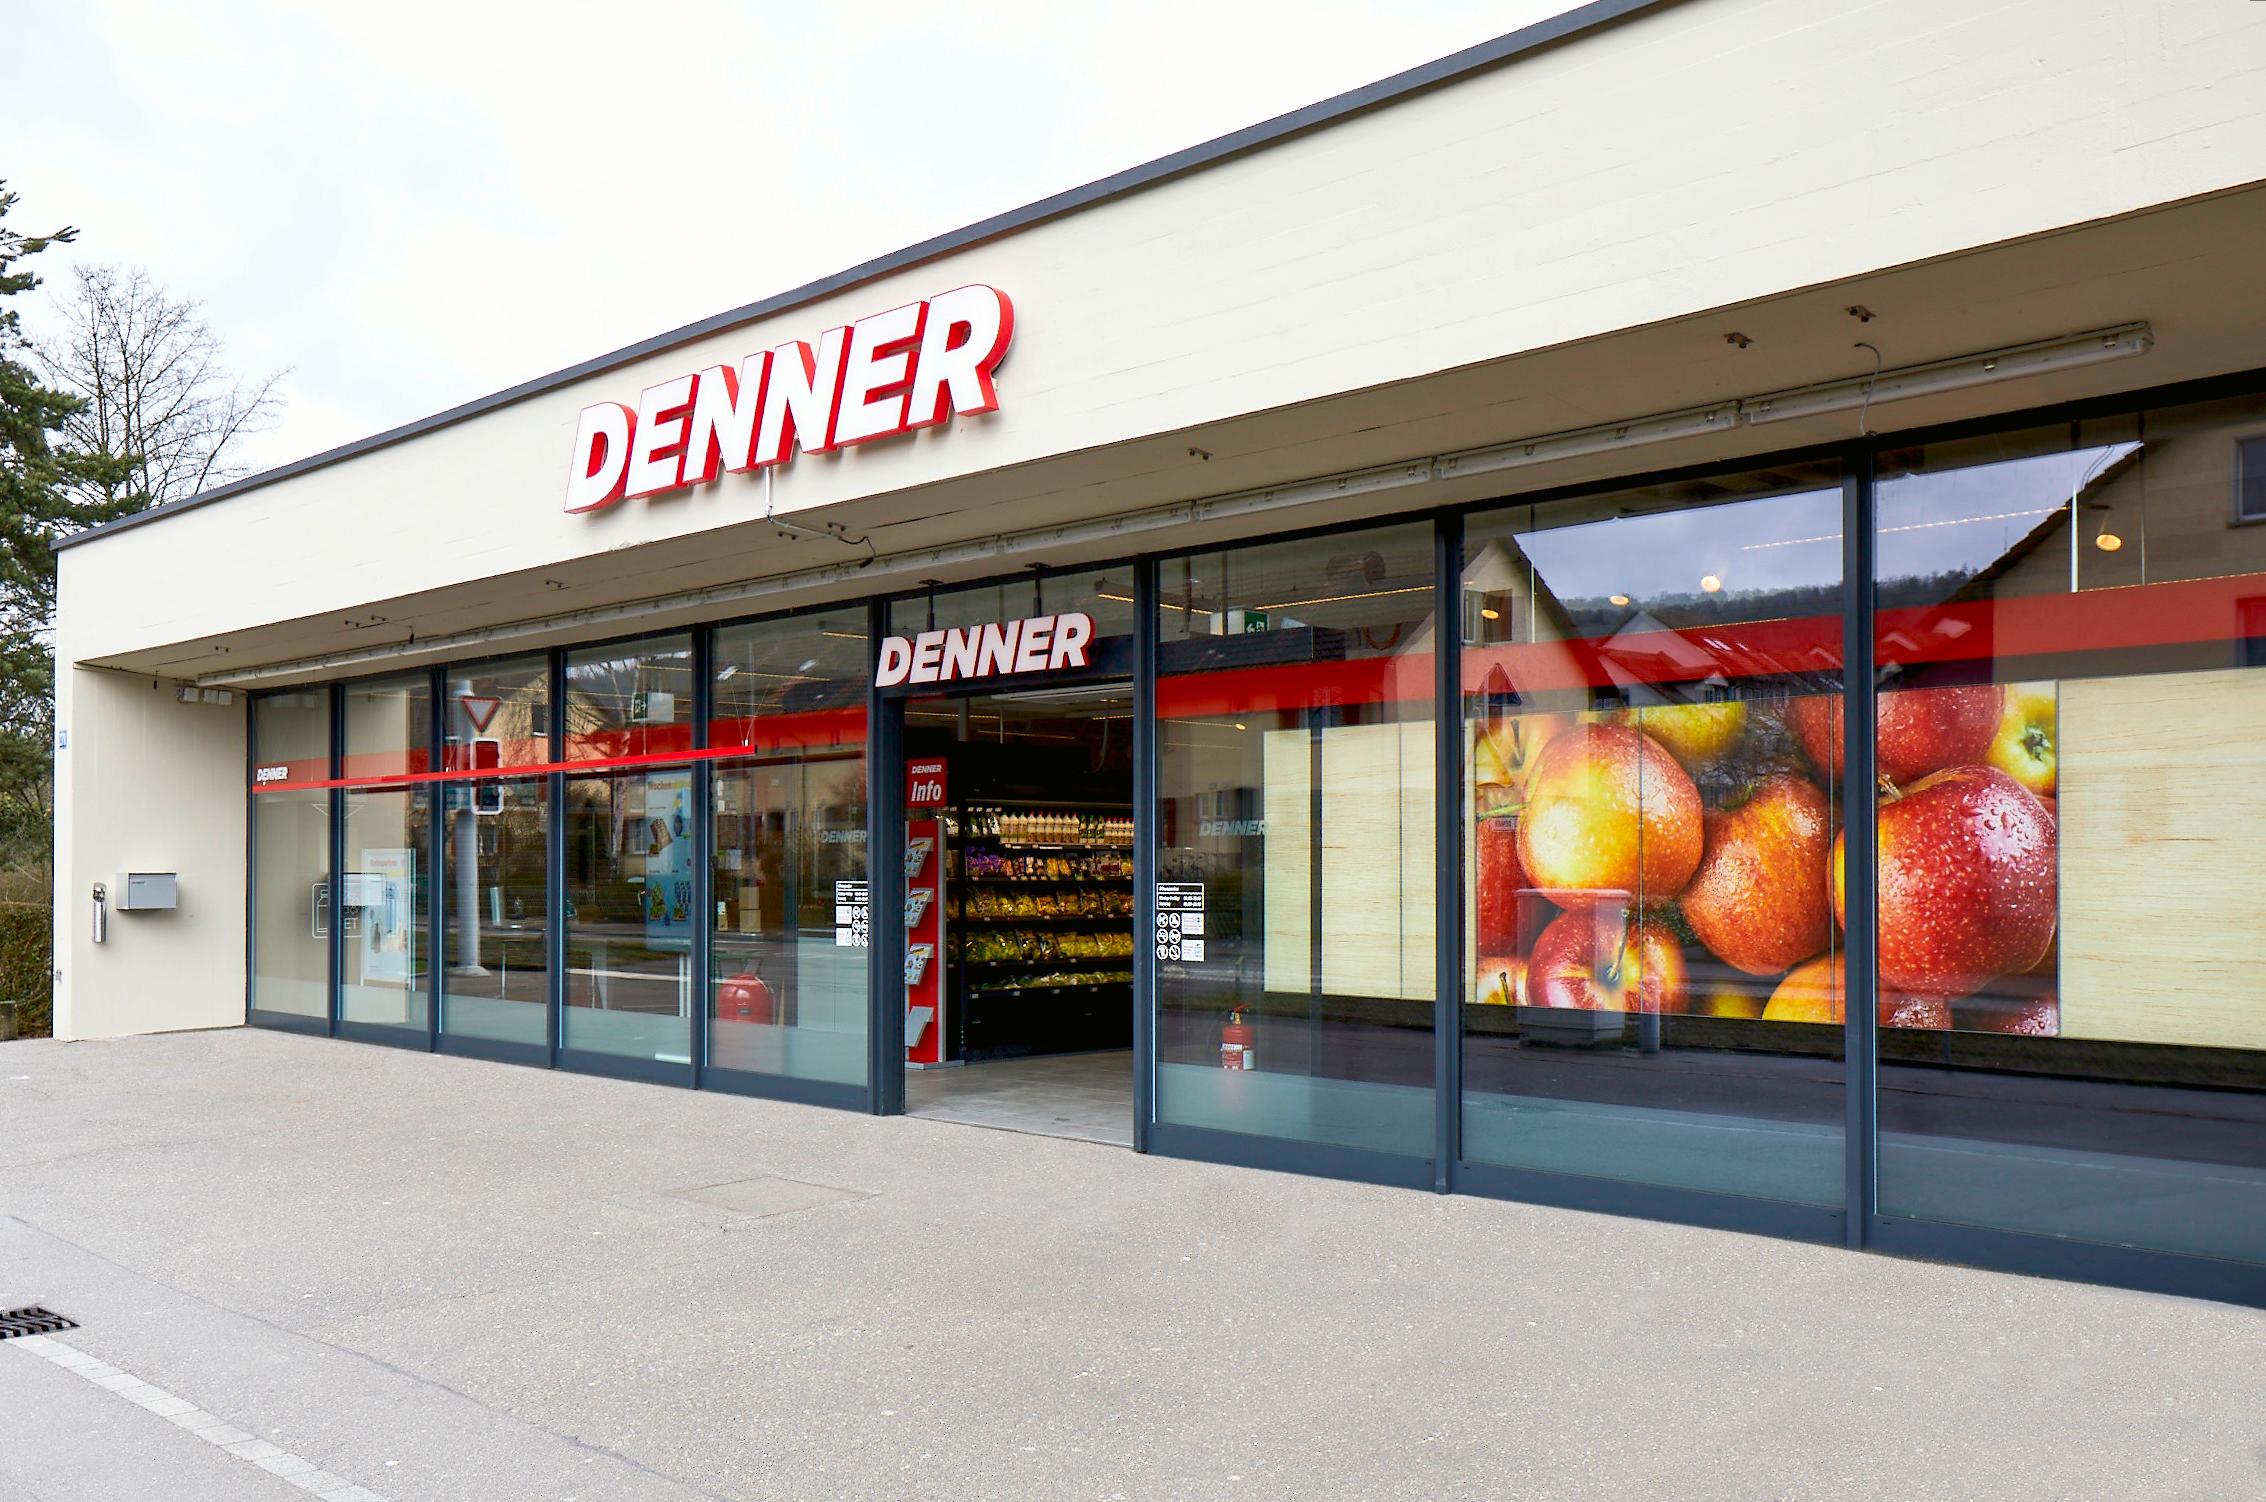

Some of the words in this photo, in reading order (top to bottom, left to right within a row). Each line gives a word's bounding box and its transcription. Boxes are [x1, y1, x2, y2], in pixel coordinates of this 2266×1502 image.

[564, 284, 1014, 513] DENNER
[875, 612, 1095, 687] DENNER
[257, 766, 288, 781] DENNER
[911, 764, 942, 774] DENNER
[911, 780, 942, 801] Info
[822, 829, 867, 843] DENNER
[1200, 820, 1266, 836] DENNER
